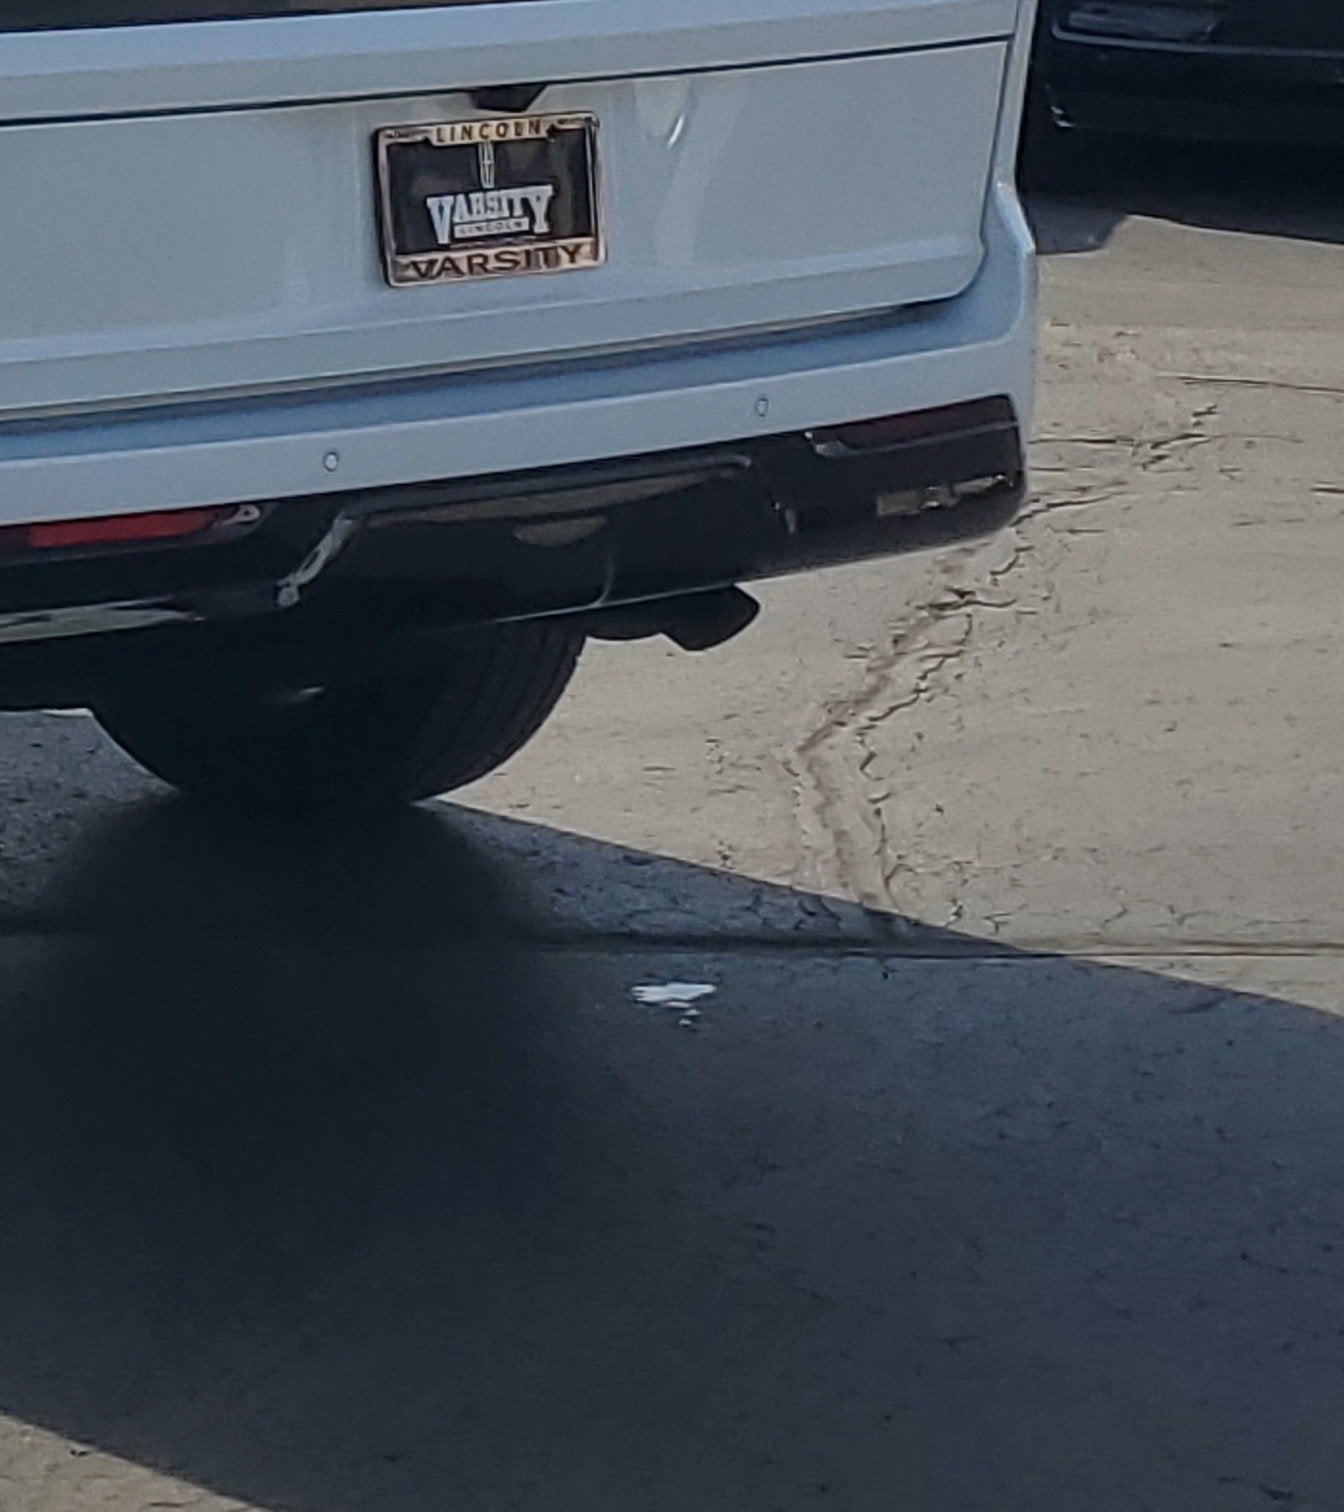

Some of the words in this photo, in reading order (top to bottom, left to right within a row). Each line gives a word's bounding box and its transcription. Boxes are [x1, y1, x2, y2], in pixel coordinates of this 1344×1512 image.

[435, 119, 541, 143] LINCOLN
[427, 185, 553, 244] VARSITY
[411, 245, 580, 278] VARSITY
